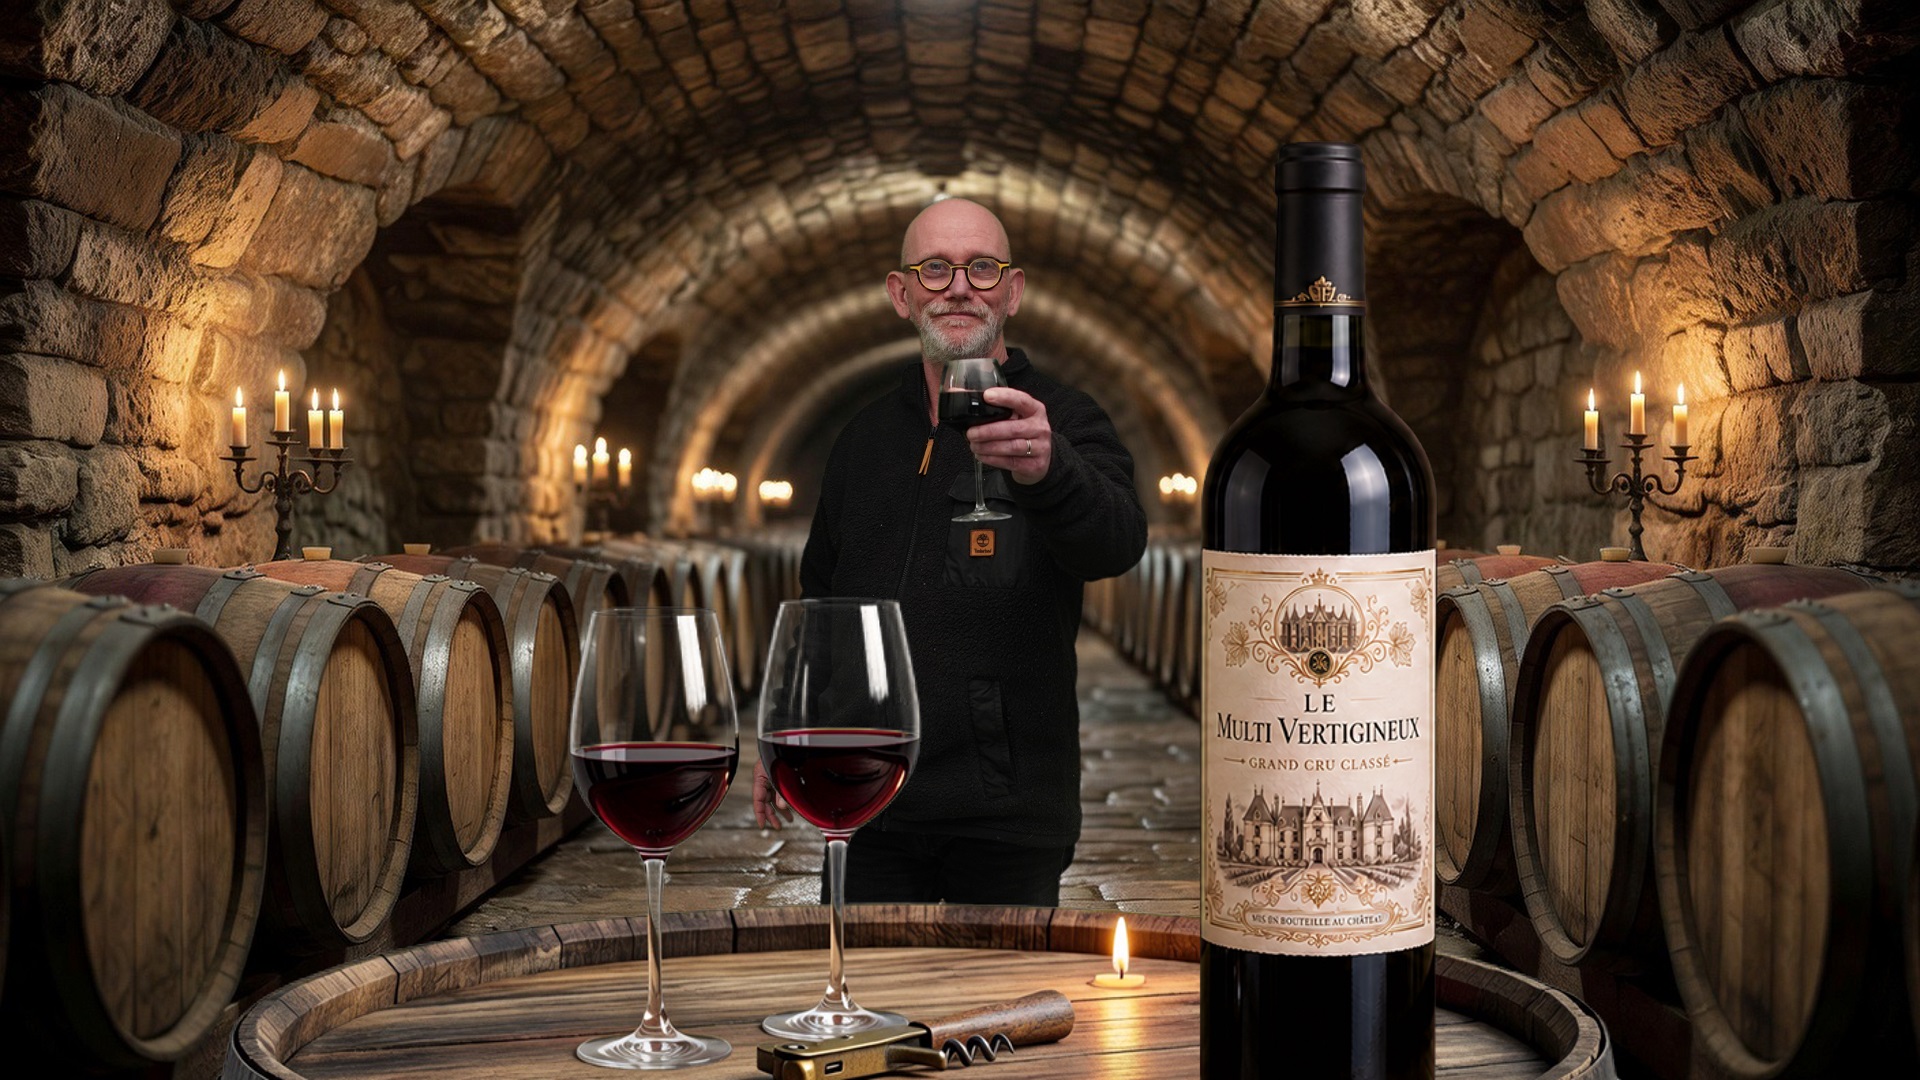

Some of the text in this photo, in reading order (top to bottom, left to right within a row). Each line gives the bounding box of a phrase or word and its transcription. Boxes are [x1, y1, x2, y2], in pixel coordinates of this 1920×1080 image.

[1304, 694, 1335, 713] LE
[1249, 753, 1390, 771] GRAND CRU CLASSÉ
[1280, 916, 1330, 926] BOUTEILLE
[1332, 917, 1345, 926] AU
